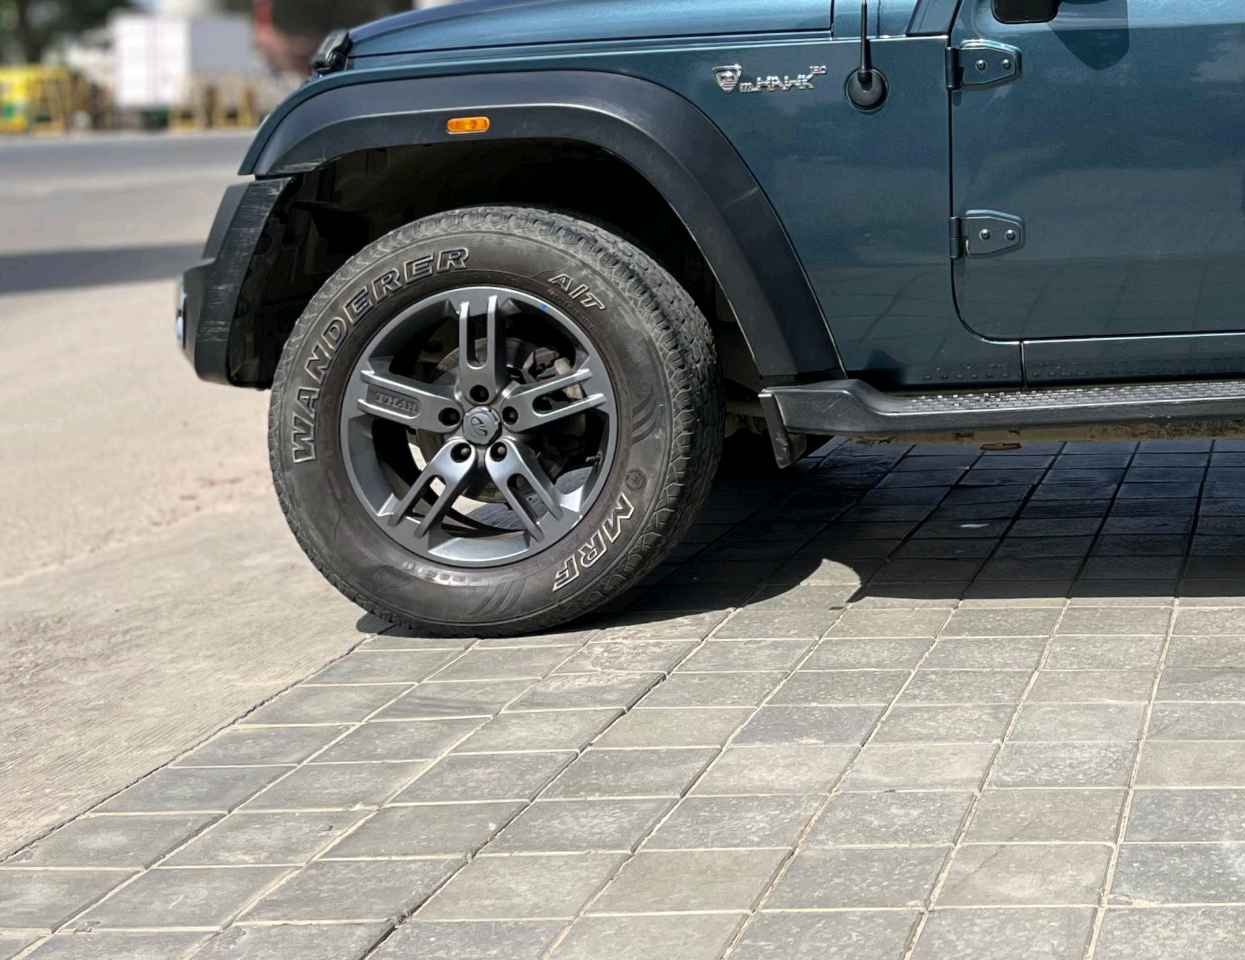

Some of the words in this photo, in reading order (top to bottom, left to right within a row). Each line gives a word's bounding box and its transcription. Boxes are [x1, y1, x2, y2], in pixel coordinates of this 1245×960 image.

[547, 273, 606, 311] A/T
[292, 247, 471, 465] WANDERER
[552, 495, 635, 594] MRF
